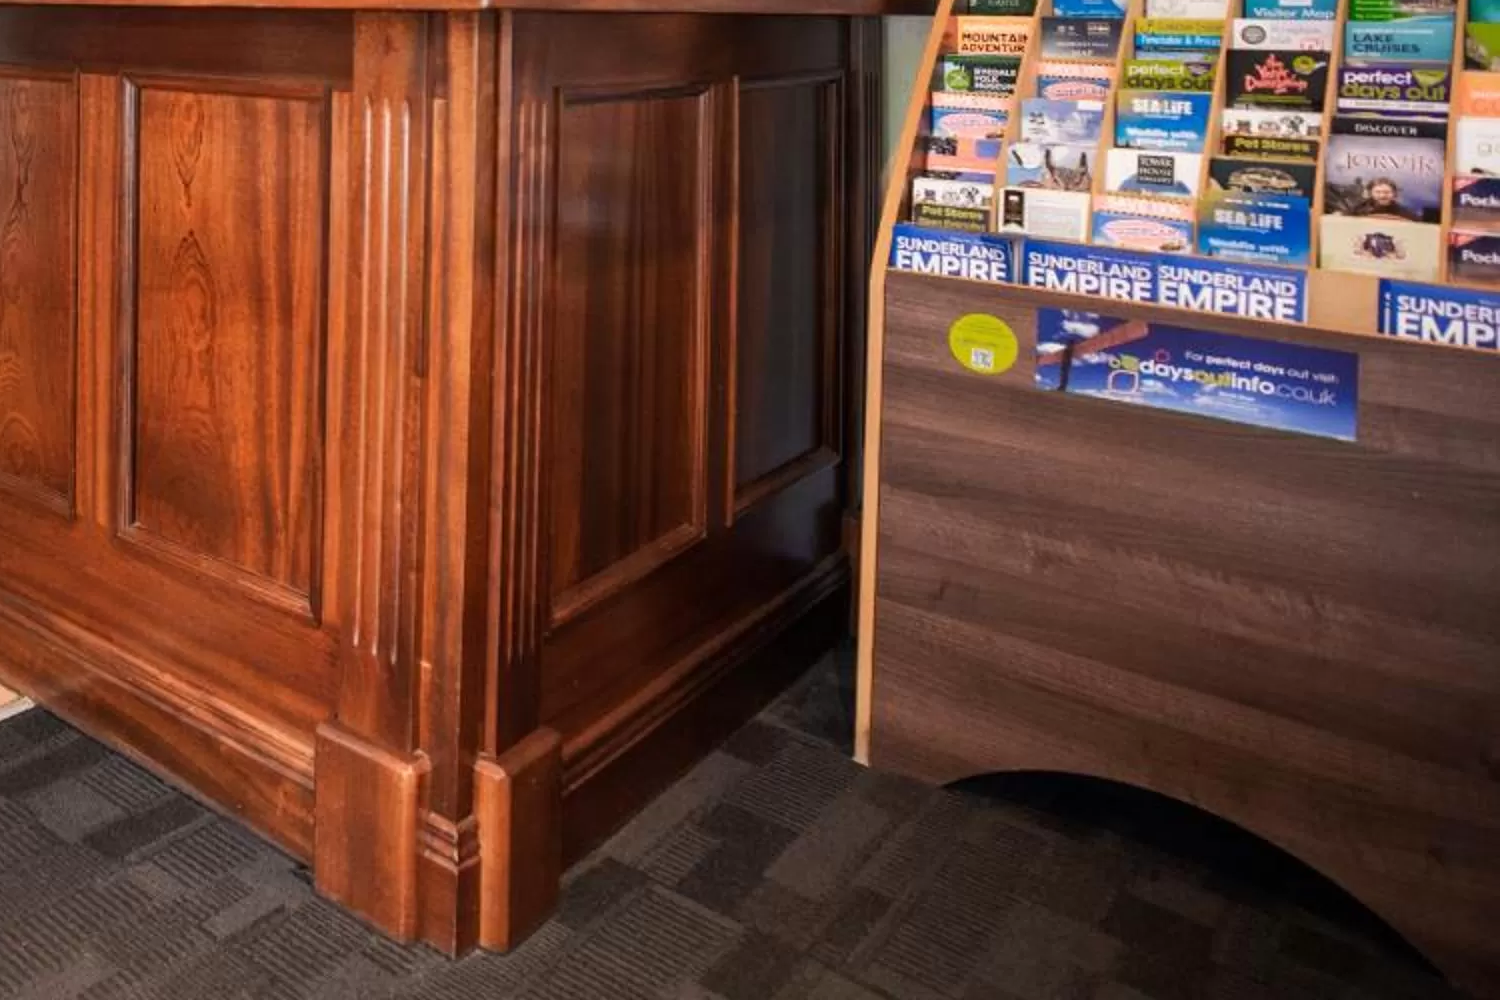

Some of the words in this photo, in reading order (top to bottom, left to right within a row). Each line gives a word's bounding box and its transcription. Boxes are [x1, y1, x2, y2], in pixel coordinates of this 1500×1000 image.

[1302, 8, 1335, 19] Map
[1352, 34, 1394, 43] LAKE
[1352, 44, 1421, 54] CRUISES
[1128, 64, 1184, 77] perfect
[1343, 70, 1412, 87] perfect
[1127, 77, 1174, 90] days
[1341, 83, 1400, 99] days
[1405, 85, 1445, 100] out
[1131, 98, 1161, 113] SEA
[1165, 100, 1192, 115] LIFE
[1354, 122, 1418, 135] DISCOVER
[1214, 209, 1246, 226] SEA
[1250, 212, 1283, 231] LIFE
[896, 237, 1004, 260] SUNDERLAND
[896, 252, 1006, 282] EMPIRE
[1028, 252, 1152, 281] SUNDERLAND
[1028, 268, 1152, 302] EMPIRE
[1161, 266, 1297, 297] SUNDERLAND
[1158, 280, 1297, 323] EMPIRE
[1185, 351, 1204, 361] For
[1205, 355, 1251, 369] perfect
[1253, 362, 1285, 376] days
[1287, 368, 1310, 380] out
